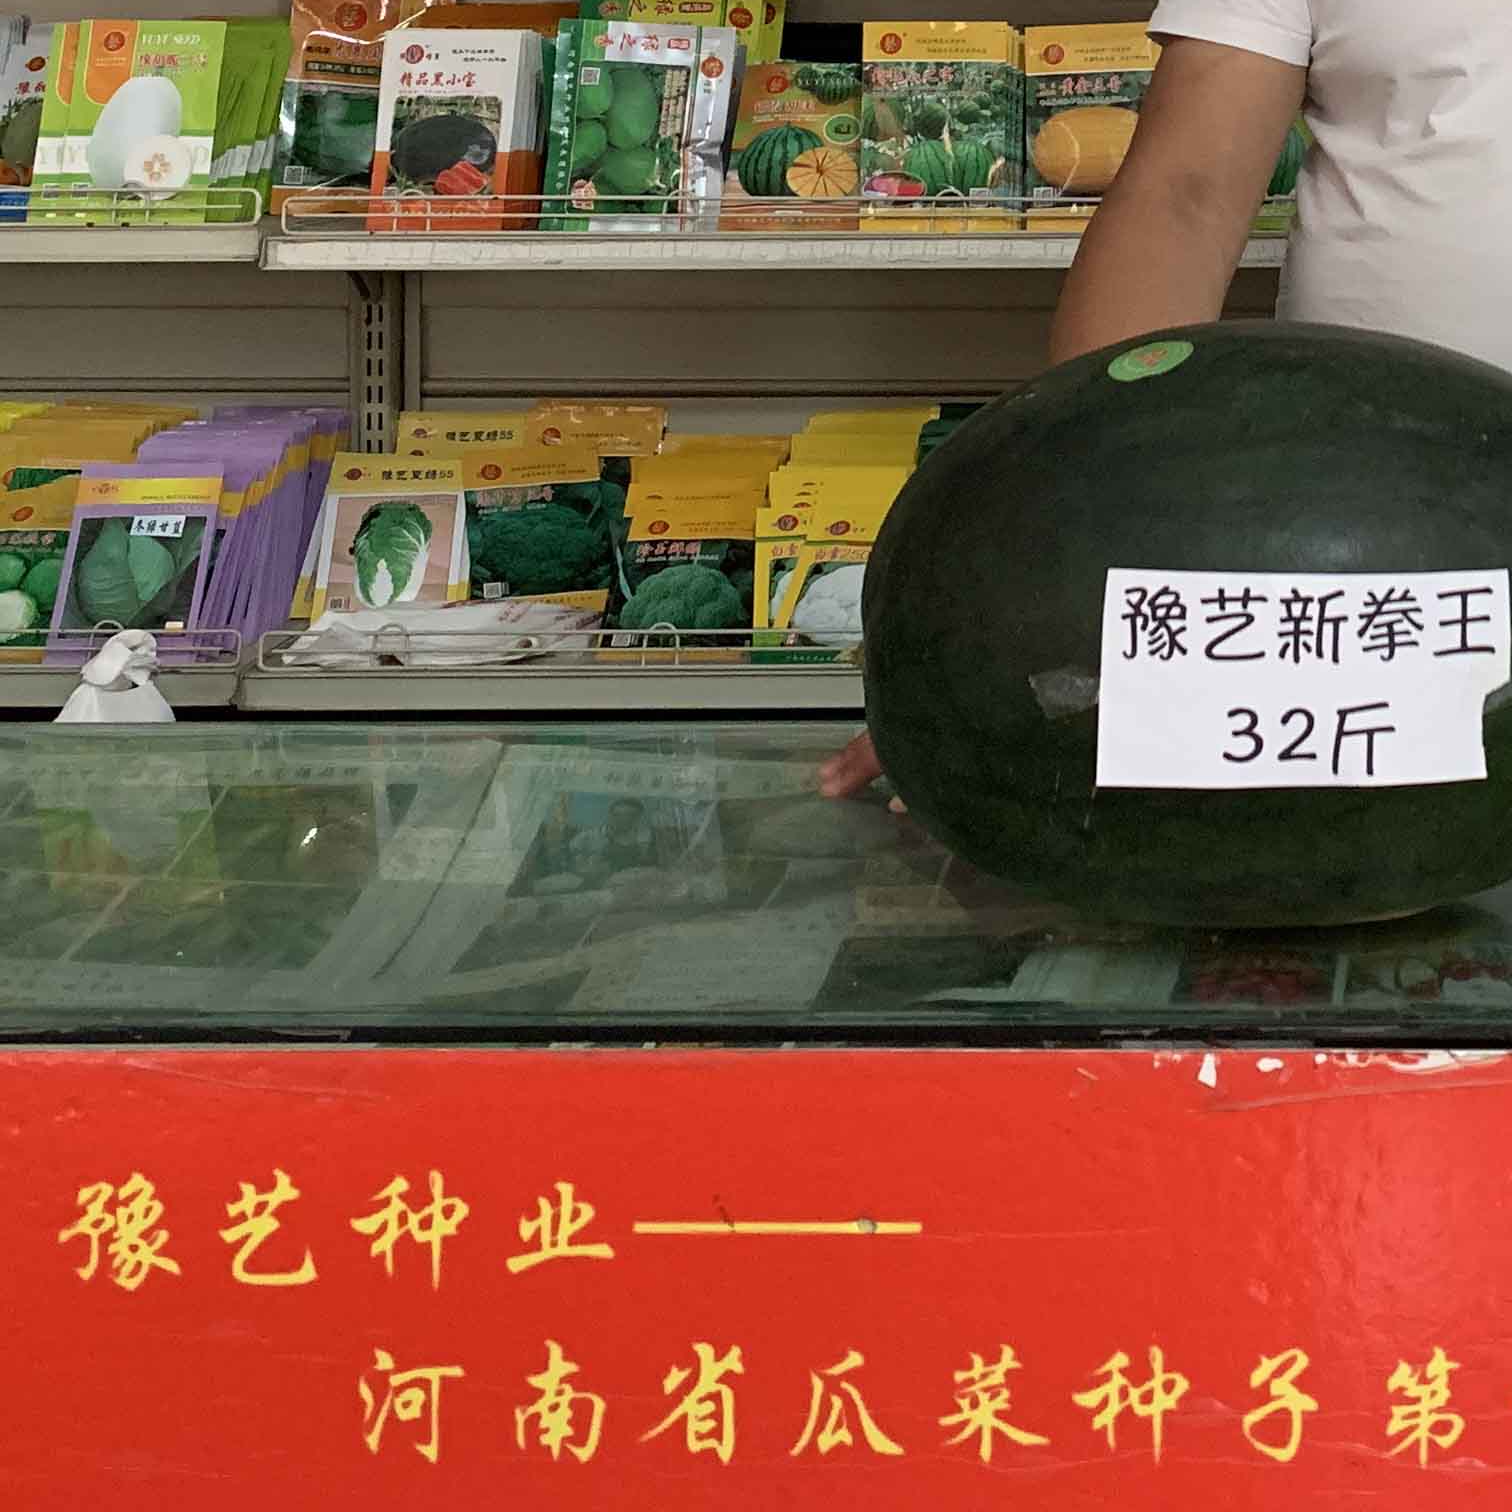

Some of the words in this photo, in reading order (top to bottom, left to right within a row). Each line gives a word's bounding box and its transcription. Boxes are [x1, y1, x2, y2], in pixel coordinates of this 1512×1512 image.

[1120, 585, 1496, 665] 豫艺新拳王
[1222, 701, 1396, 777] 32斤
